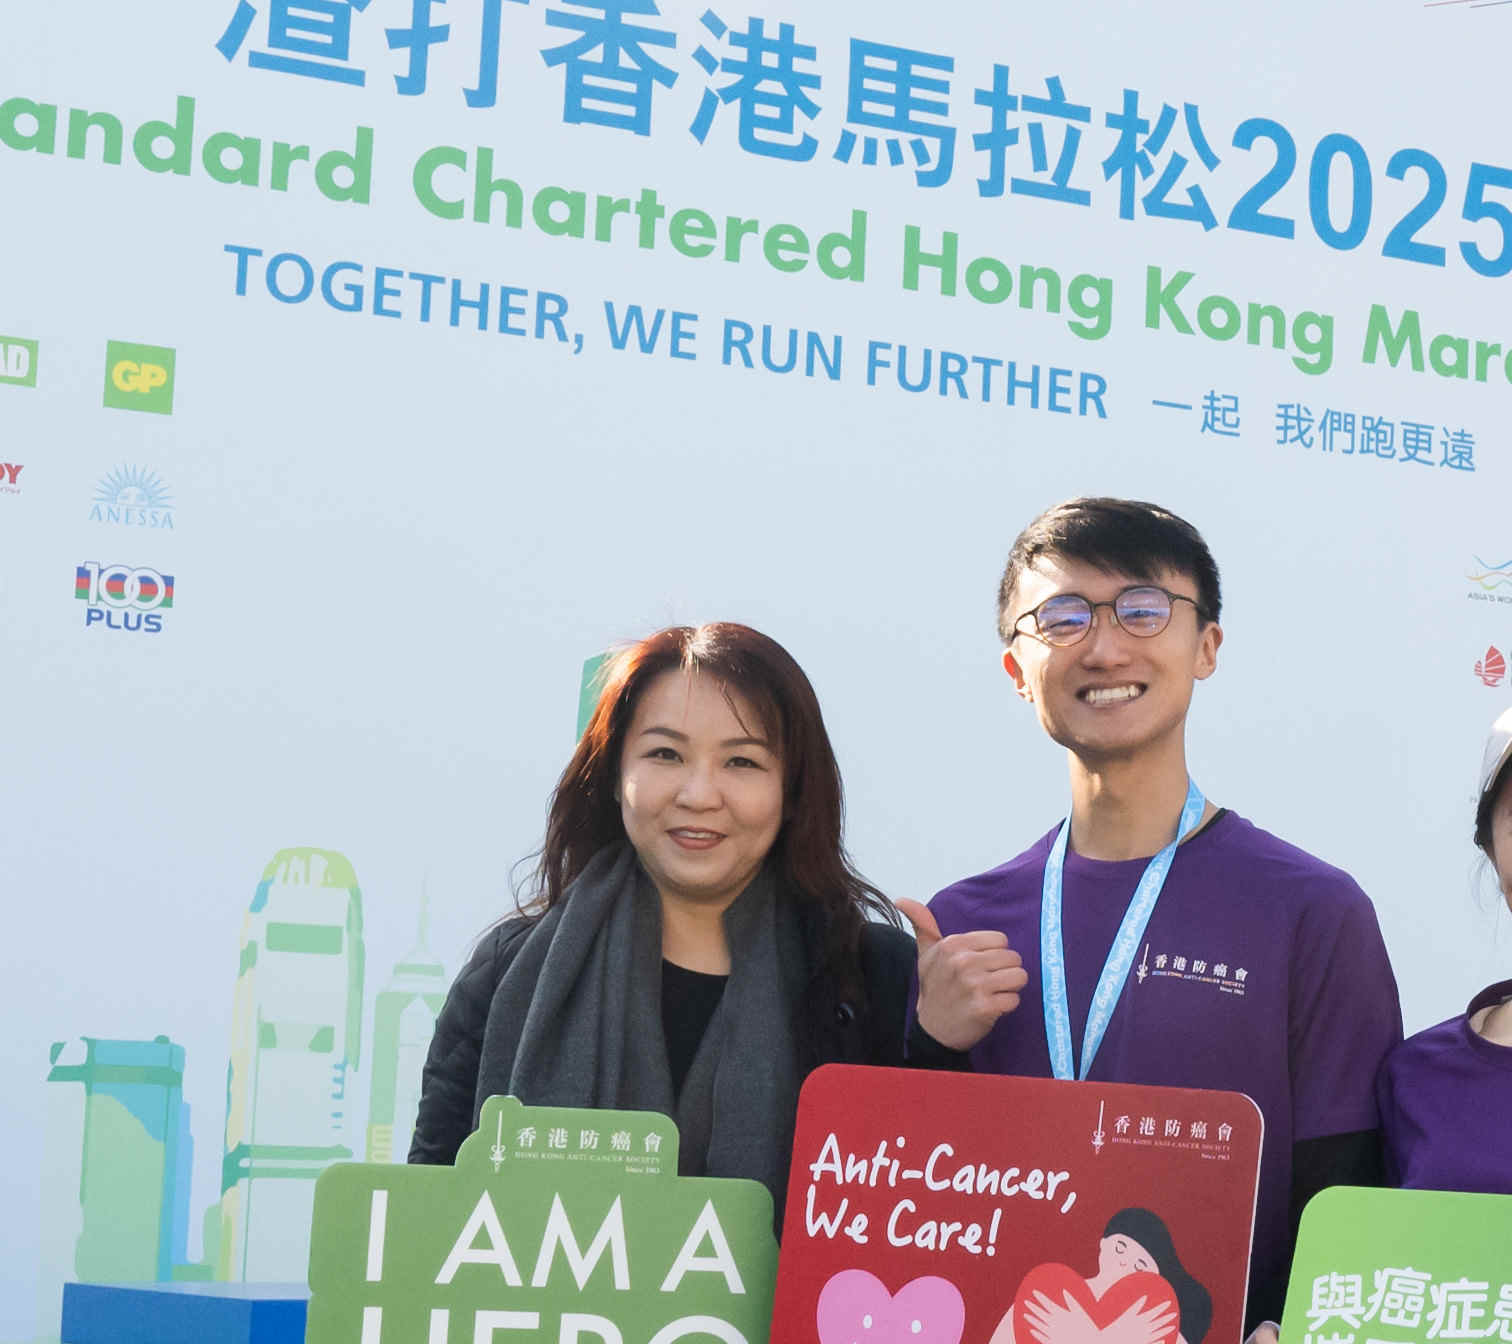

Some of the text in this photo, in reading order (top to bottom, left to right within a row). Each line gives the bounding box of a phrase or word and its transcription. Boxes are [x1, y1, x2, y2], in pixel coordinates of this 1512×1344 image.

[411, 145, 868, 284] Chartered
[902, 224, 1114, 341] Hong
[1144, 264, 1336, 376] Kong
[111, 359, 168, 394] GP
[223, 244, 1478, 474] TOGETHER, WE RUN FURTHER 一起 我們跑更遠
[88, 502, 175, 531] ANESSA
[83, 560, 167, 611] 100
[86, 607, 163, 633] PLUS
[517, 1126, 663, 1154] 香港防癌會
[1114, 1115, 1234, 1142] 香港防癌會
[809, 1132, 1078, 1215] Anti-Cancer,
[365, 1188, 747, 1295] I AM A
[805, 1184, 1002, 1257] We Care!
